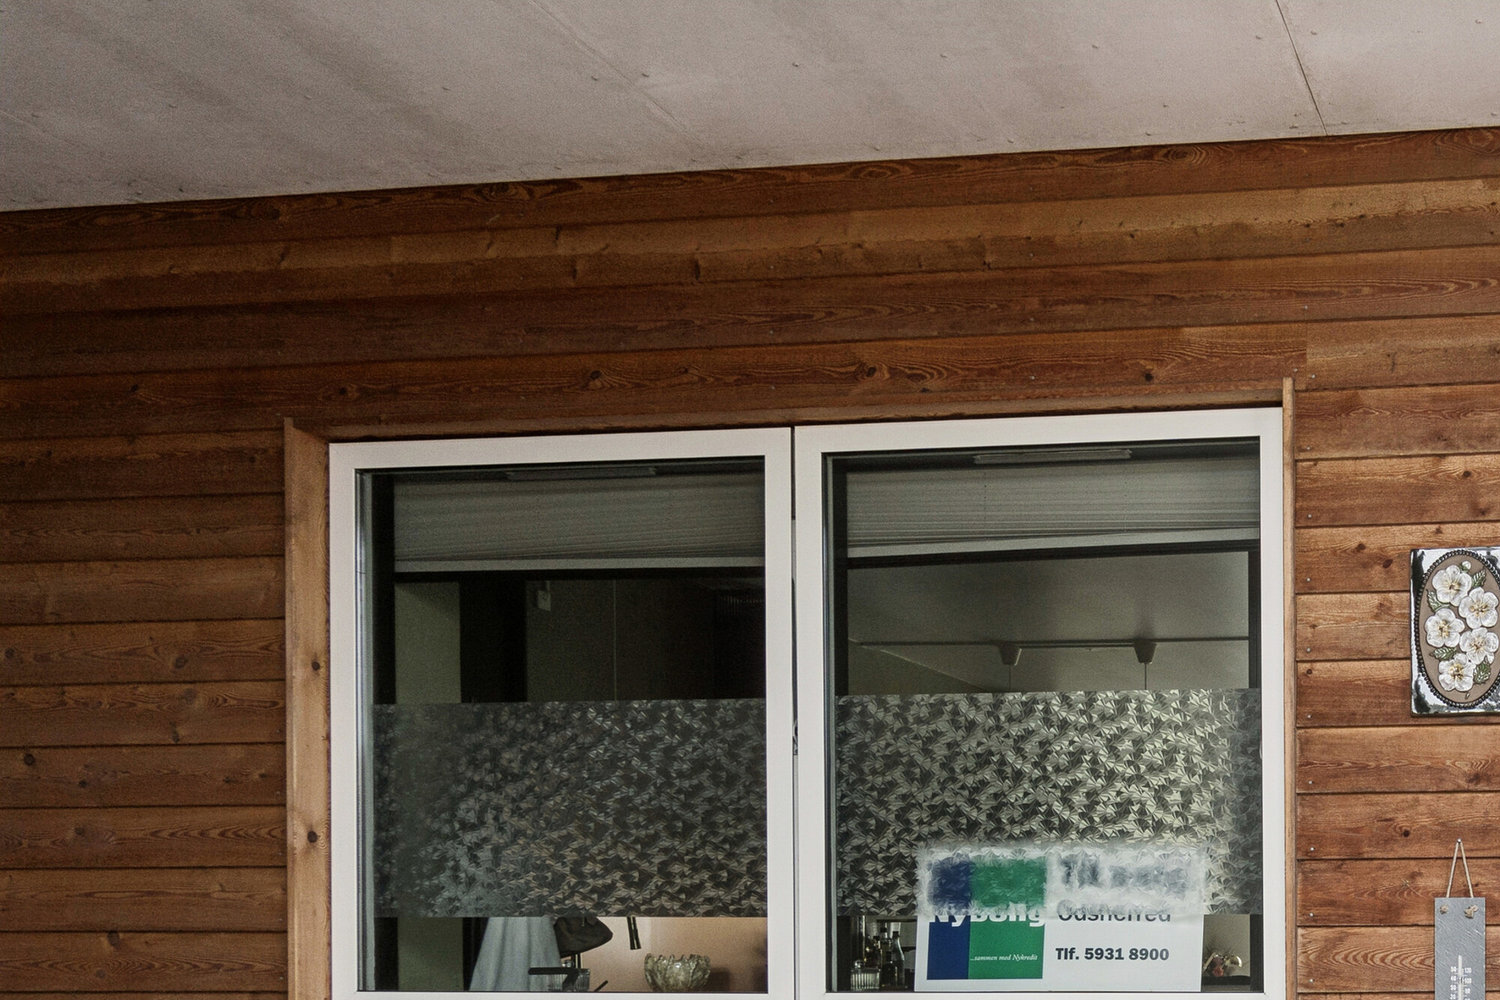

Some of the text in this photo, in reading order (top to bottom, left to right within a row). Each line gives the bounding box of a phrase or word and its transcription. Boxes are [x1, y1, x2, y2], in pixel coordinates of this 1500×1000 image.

[1055, 947, 1170, 961] Tlf. 5931 8900
